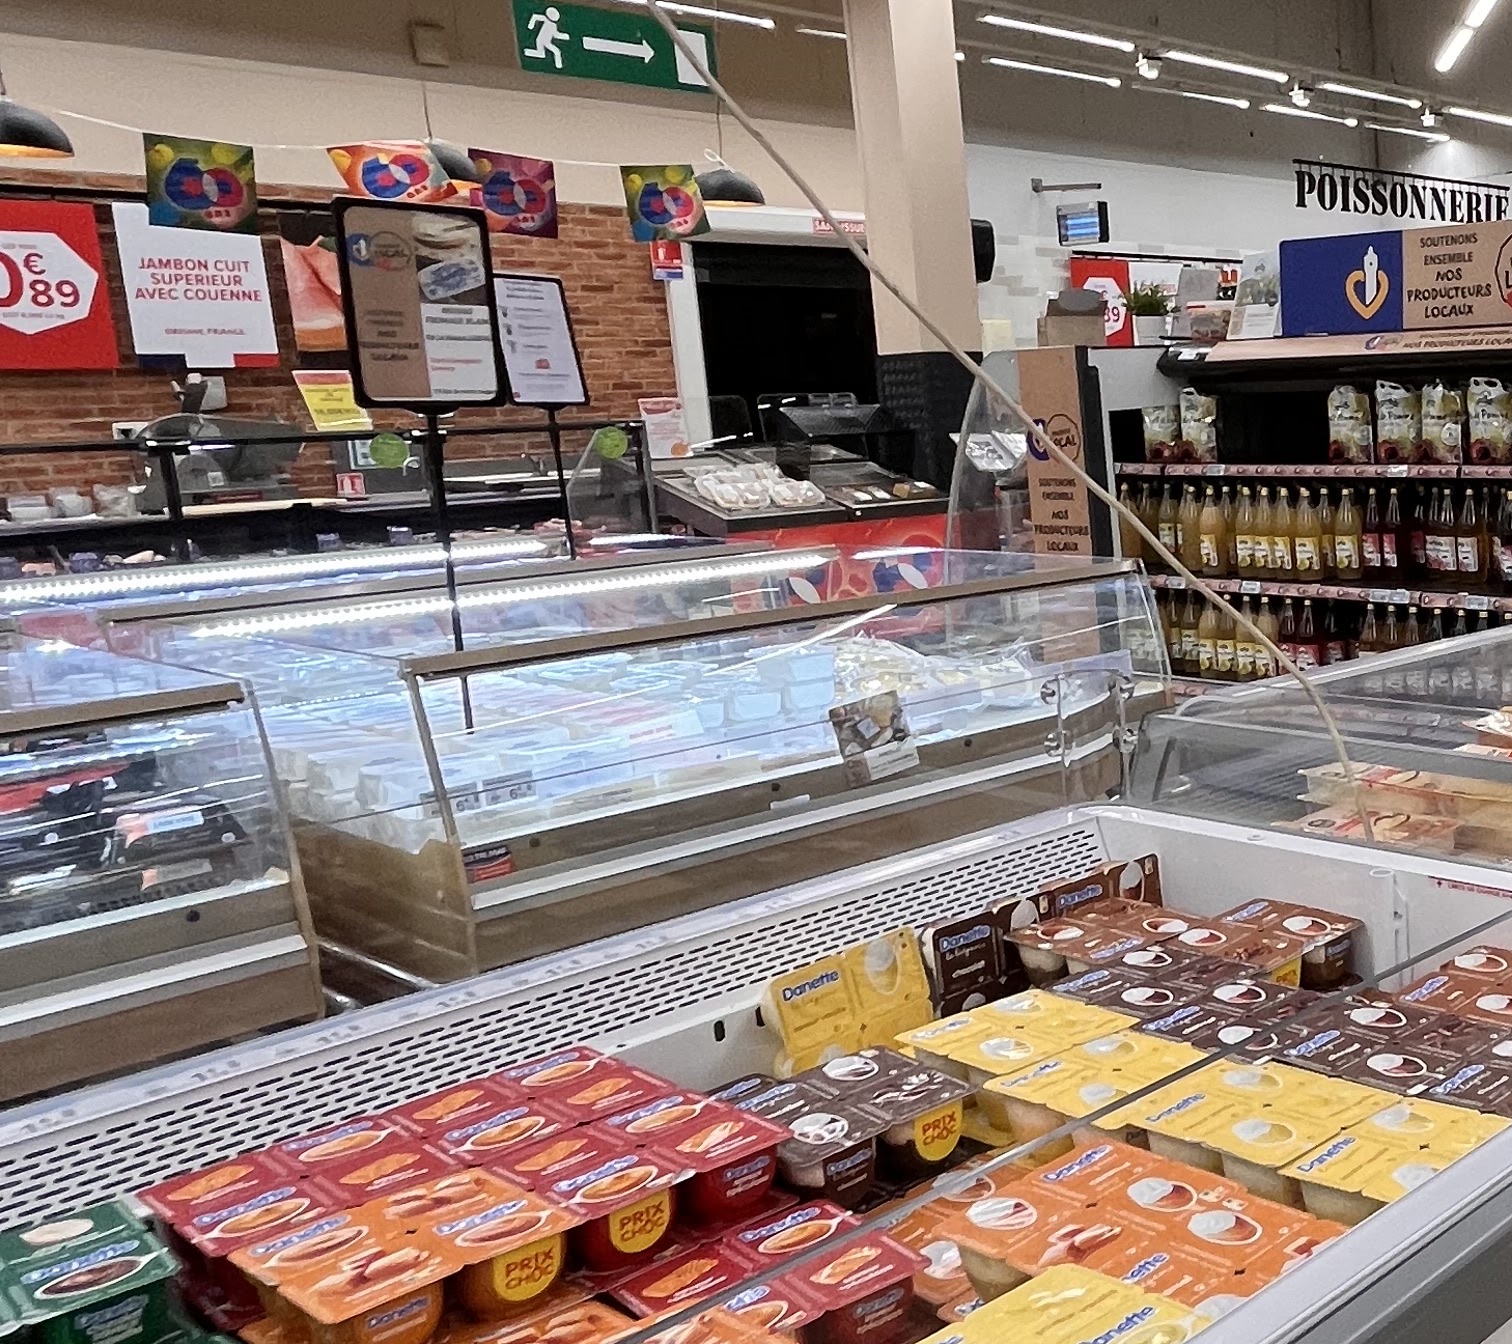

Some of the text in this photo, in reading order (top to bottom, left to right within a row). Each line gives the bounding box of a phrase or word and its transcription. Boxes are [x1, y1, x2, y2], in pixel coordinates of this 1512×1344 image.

[1294, 169, 1510, 223] POISSONNERIE
[1419, 232, 1478, 248] SOUTENONS
[138, 258, 250, 272] JAMBON CUIT
[1423, 251, 1473, 266] ENSEMBLE
[150, 273, 243, 286] SUPERIEUR
[1435, 267, 1463, 282] NOS
[135, 288, 262, 302] AVEC COUENNE
[1407, 283, 1492, 302] PRODUCTEURS
[1424, 303, 1475, 319] LOCAUX
[782, 969, 841, 1003] Danette
[922, 1111, 957, 1134] PRIX
[923, 1124, 958, 1146] CHOC
[619, 1200, 665, 1232] PRIX
[620, 1218, 665, 1243] CHOC
[505, 1246, 555, 1280] PRIX
[505, 1265, 555, 1291] CHOC
